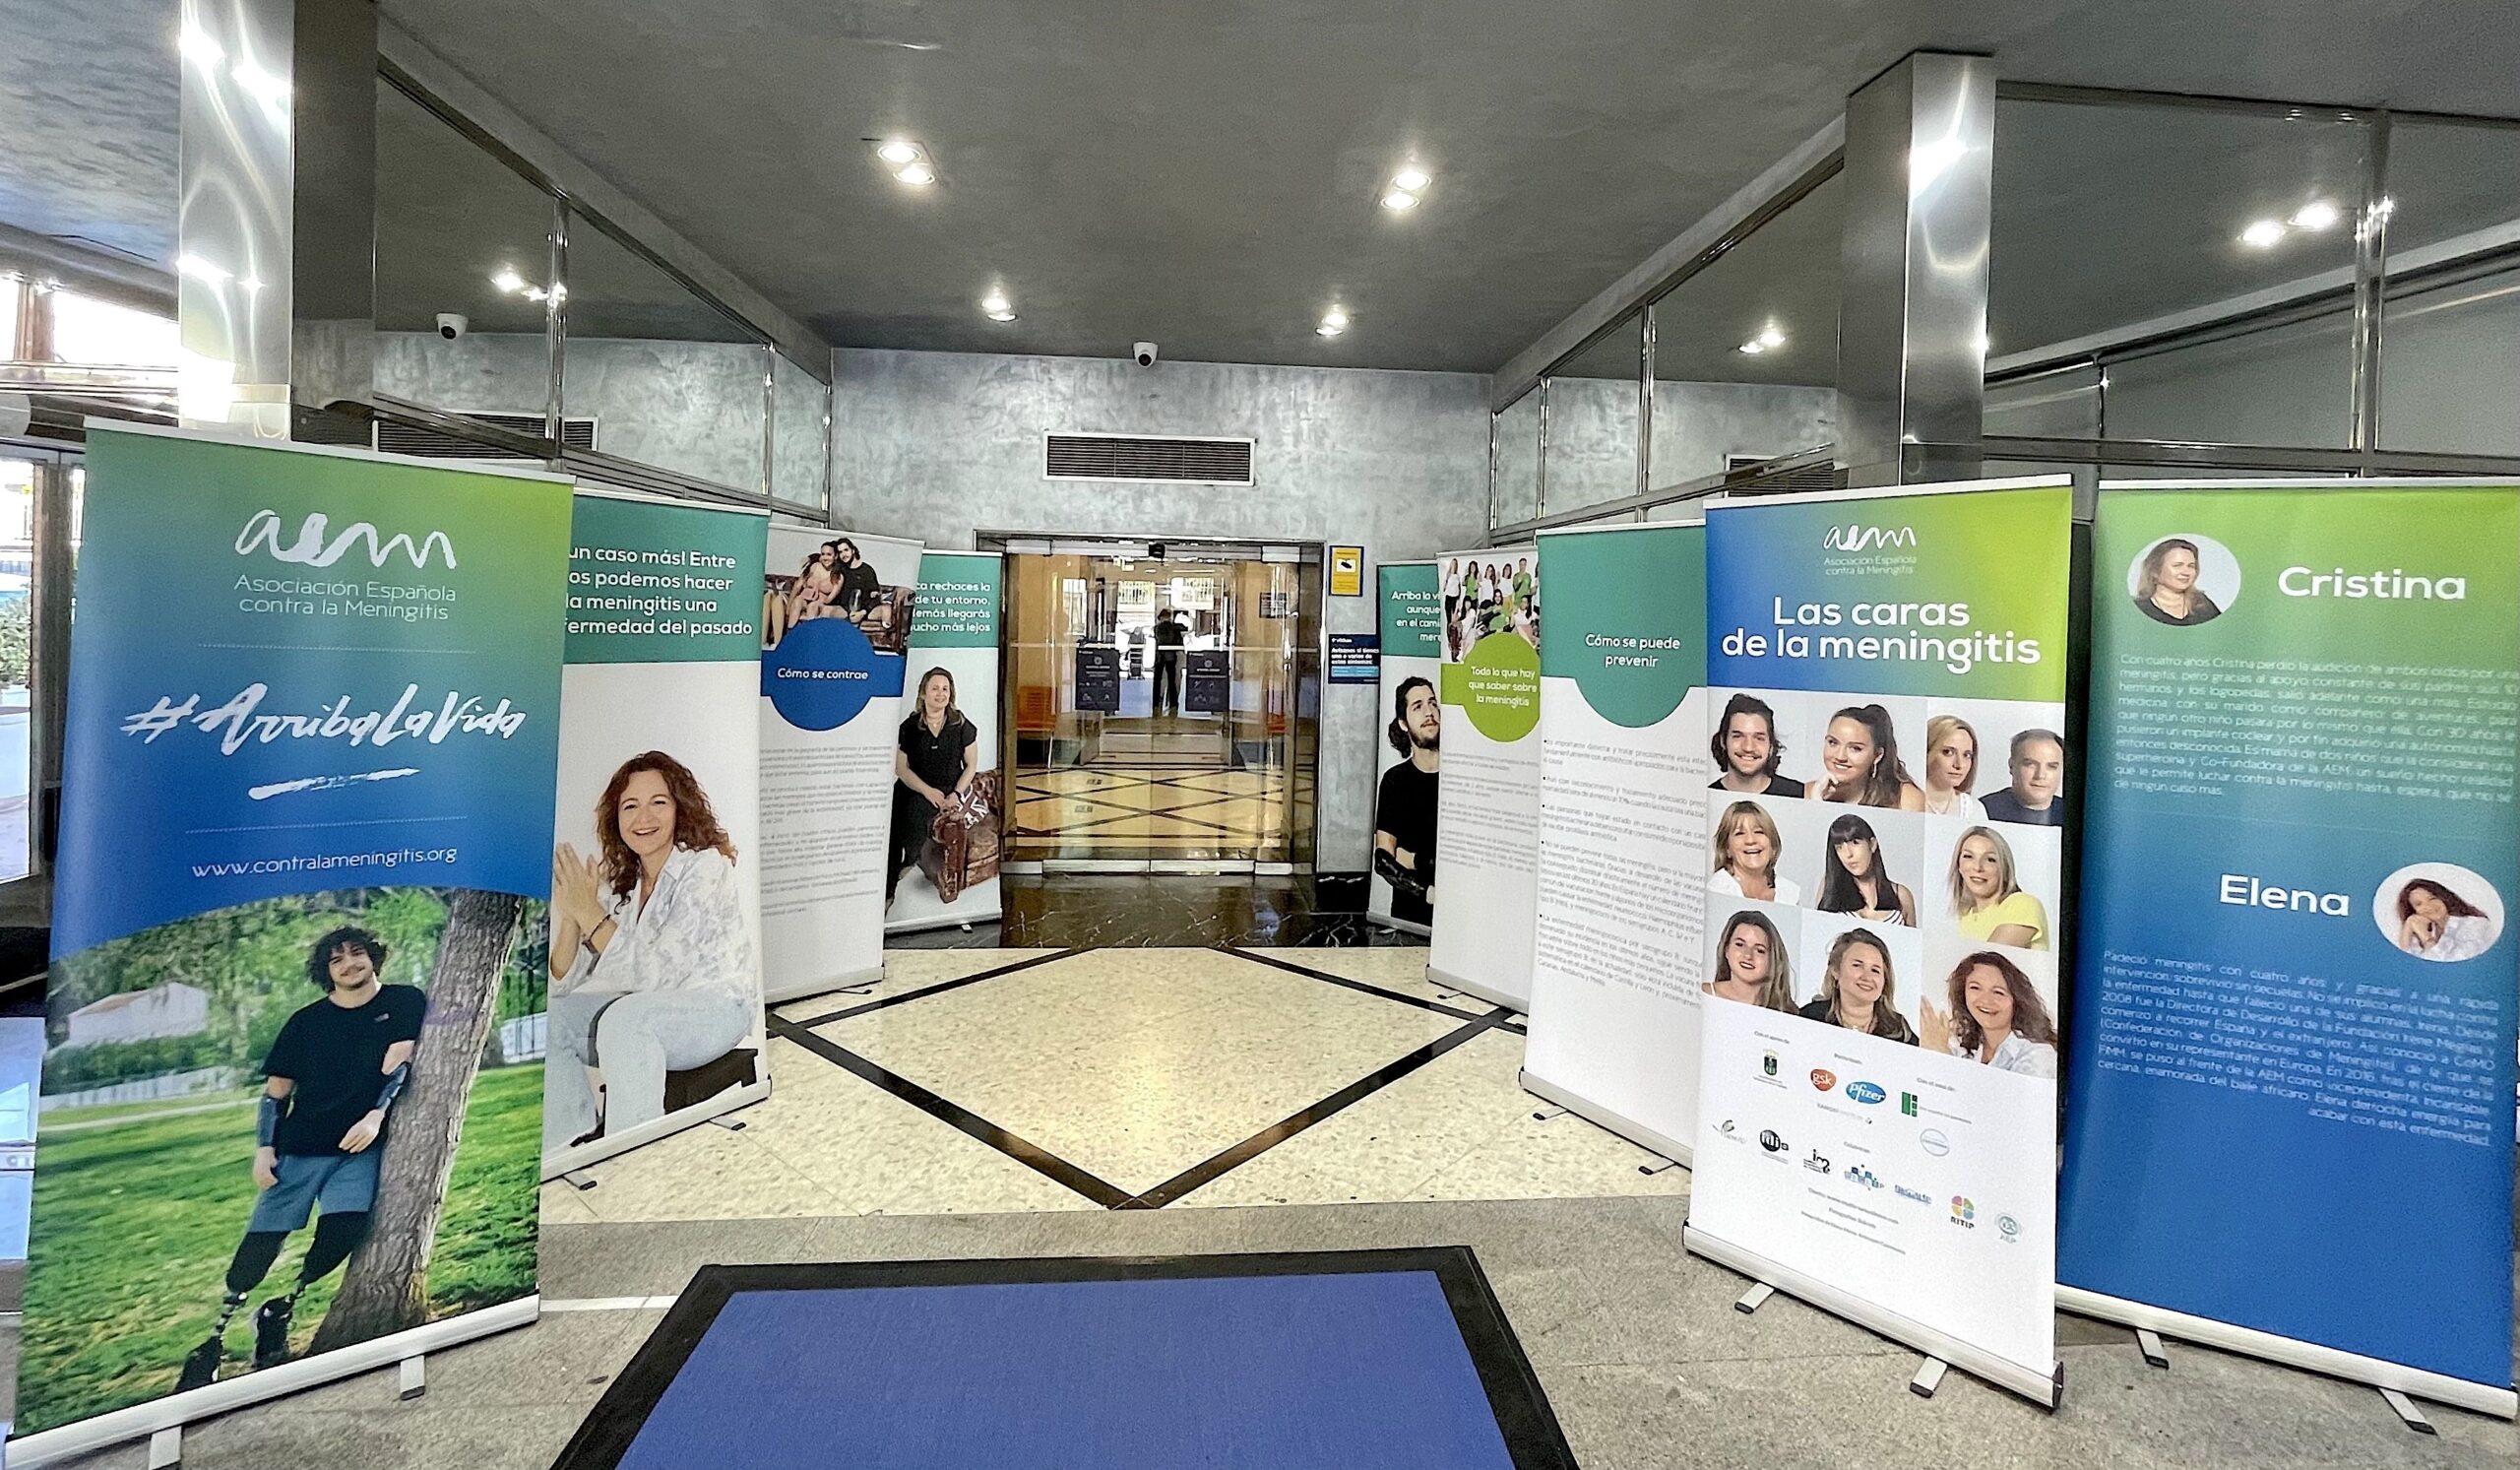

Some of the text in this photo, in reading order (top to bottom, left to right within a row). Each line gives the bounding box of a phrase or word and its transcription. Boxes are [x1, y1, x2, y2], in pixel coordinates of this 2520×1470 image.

[595, 548, 638, 562] caso
[642, 549, 685, 565] más!
[690, 551, 736, 568] Entre
[1866, 566, 1914, 576] Meningitis
[569, 571, 733, 590] os podemos hacer
[929, 582, 978, 591] rechaces
[2278, 566, 2466, 601] Cristina
[234, 575, 456, 602] Asociación Española
[1391, 591, 1420, 600] Arriba
[1422, 591, 1430, 600] la
[239, 598, 449, 622] contra la Meningitis
[587, 595, 681, 615] meningitis
[685, 599, 717, 611] una
[1407, 607, 1440, 616] aunque
[1774, 596, 1970, 626] Las caras
[947, 608, 990, 620] llegarás
[659, 619, 686, 634] del
[690, 620, 752, 637] pasado
[941, 622, 965, 631] más
[967, 622, 990, 634] lejos
[1419, 618, 1440, 627] cami
[1586, 634, 1680, 650] Cómo se puede
[1723, 628, 2041, 674] de la meningitis
[1605, 656, 1659, 668] prevenir
[778, 668, 809, 678] Cómo
[827, 670, 868, 679] contrae
[1471, 666, 1535, 680] Todo lo que hay
[1468, 681, 1537, 692] que saber sobre
[1477, 694, 1529, 709] la meningitis
[191, 847, 458, 878] www.contralameningitis.org
[2220, 873, 2350, 917] Elena
[1813, 1073, 1832, 1086] gsk
